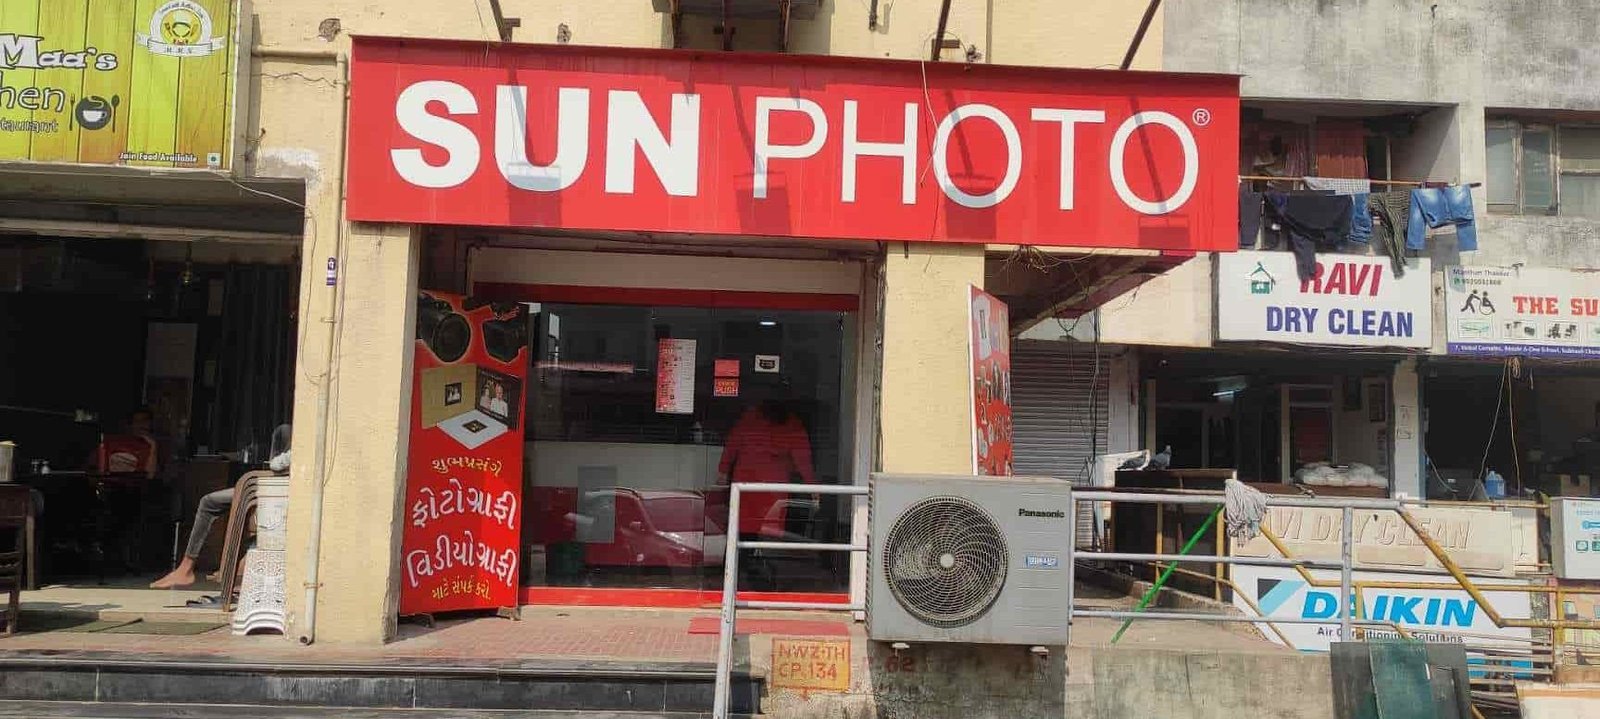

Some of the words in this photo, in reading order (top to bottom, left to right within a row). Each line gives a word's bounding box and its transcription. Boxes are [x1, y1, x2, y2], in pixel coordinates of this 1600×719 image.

[159, 153, 198, 163] Available
[390, 80, 701, 197] SUN
[754, 96, 1199, 214] PHOTO
[1299, 262, 1382, 297] RAVI
[1266, 306, 1319, 333] DRY
[1328, 308, 1414, 338] CLEAN
[1512, 295, 1559, 316] THE
[413, 478, 517, 530] ફોટોગ્રાફી
[1018, 508, 1065, 518] Panasonic
[406, 530, 517, 588] વિડીયોગ્રાફી
[1302, 591, 1477, 628] DAIKIN
[1317, 626, 1333, 636] Air
